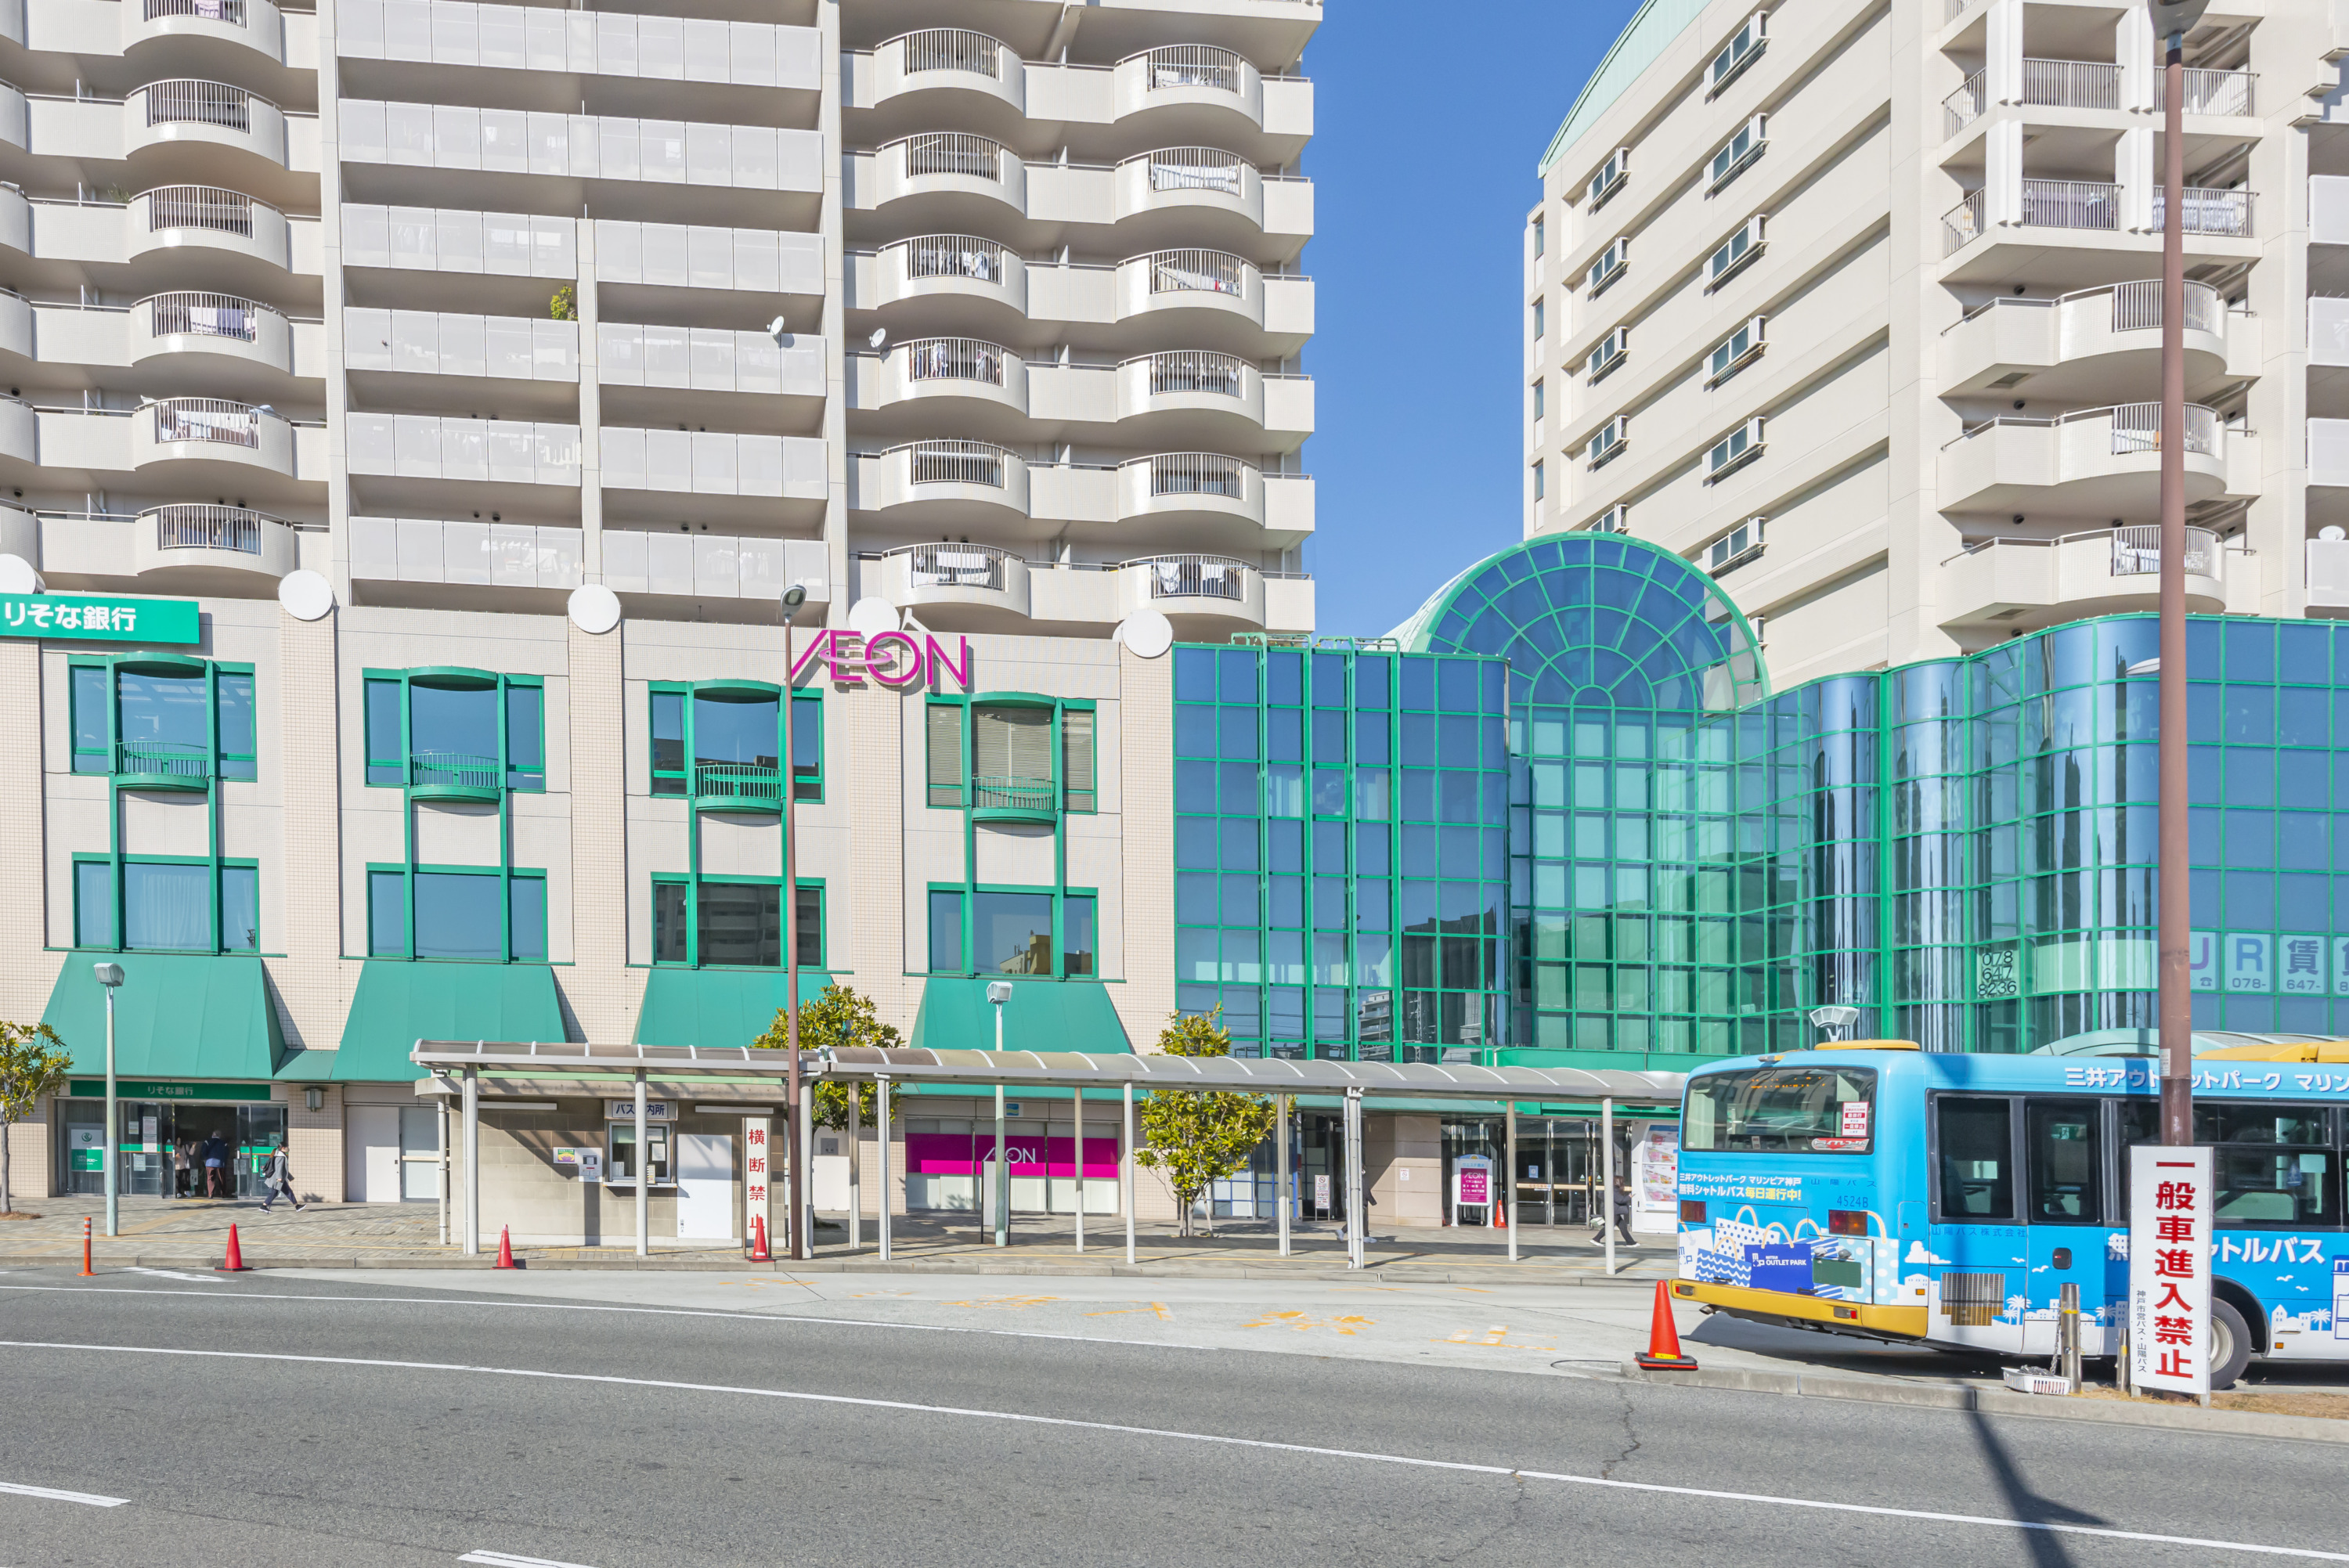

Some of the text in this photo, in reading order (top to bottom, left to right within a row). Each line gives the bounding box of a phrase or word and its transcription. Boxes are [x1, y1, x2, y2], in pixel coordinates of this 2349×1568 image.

[5, 602, 137, 632] りそな銀行
[1983, 950, 2013, 966] 078
[1983, 964, 2012, 981] 647
[1978, 981, 2017, 997] 8236
[2065, 1067, 2282, 1090] 三井アウトットパーク
[148, 1086, 193, 1095] りそな銀行
[615, 1104, 665, 1116] バス内所
[983, 1147, 1036, 1164] AON
[1680, 1173, 1802, 1187] 三井アウトレットパーク マリンピア神戸
[1836, 1195, 1869, 1208] 4524B
[1932, 1226, 2026, 1238] 山陽バス株式会社
[2108, 1232, 2326, 1263] 無トルバス
[2155, 1161, 2196, 1379] 一般車進入禁止
[2136, 1290, 2148, 1373] 神戸市営バス・山陽バス
